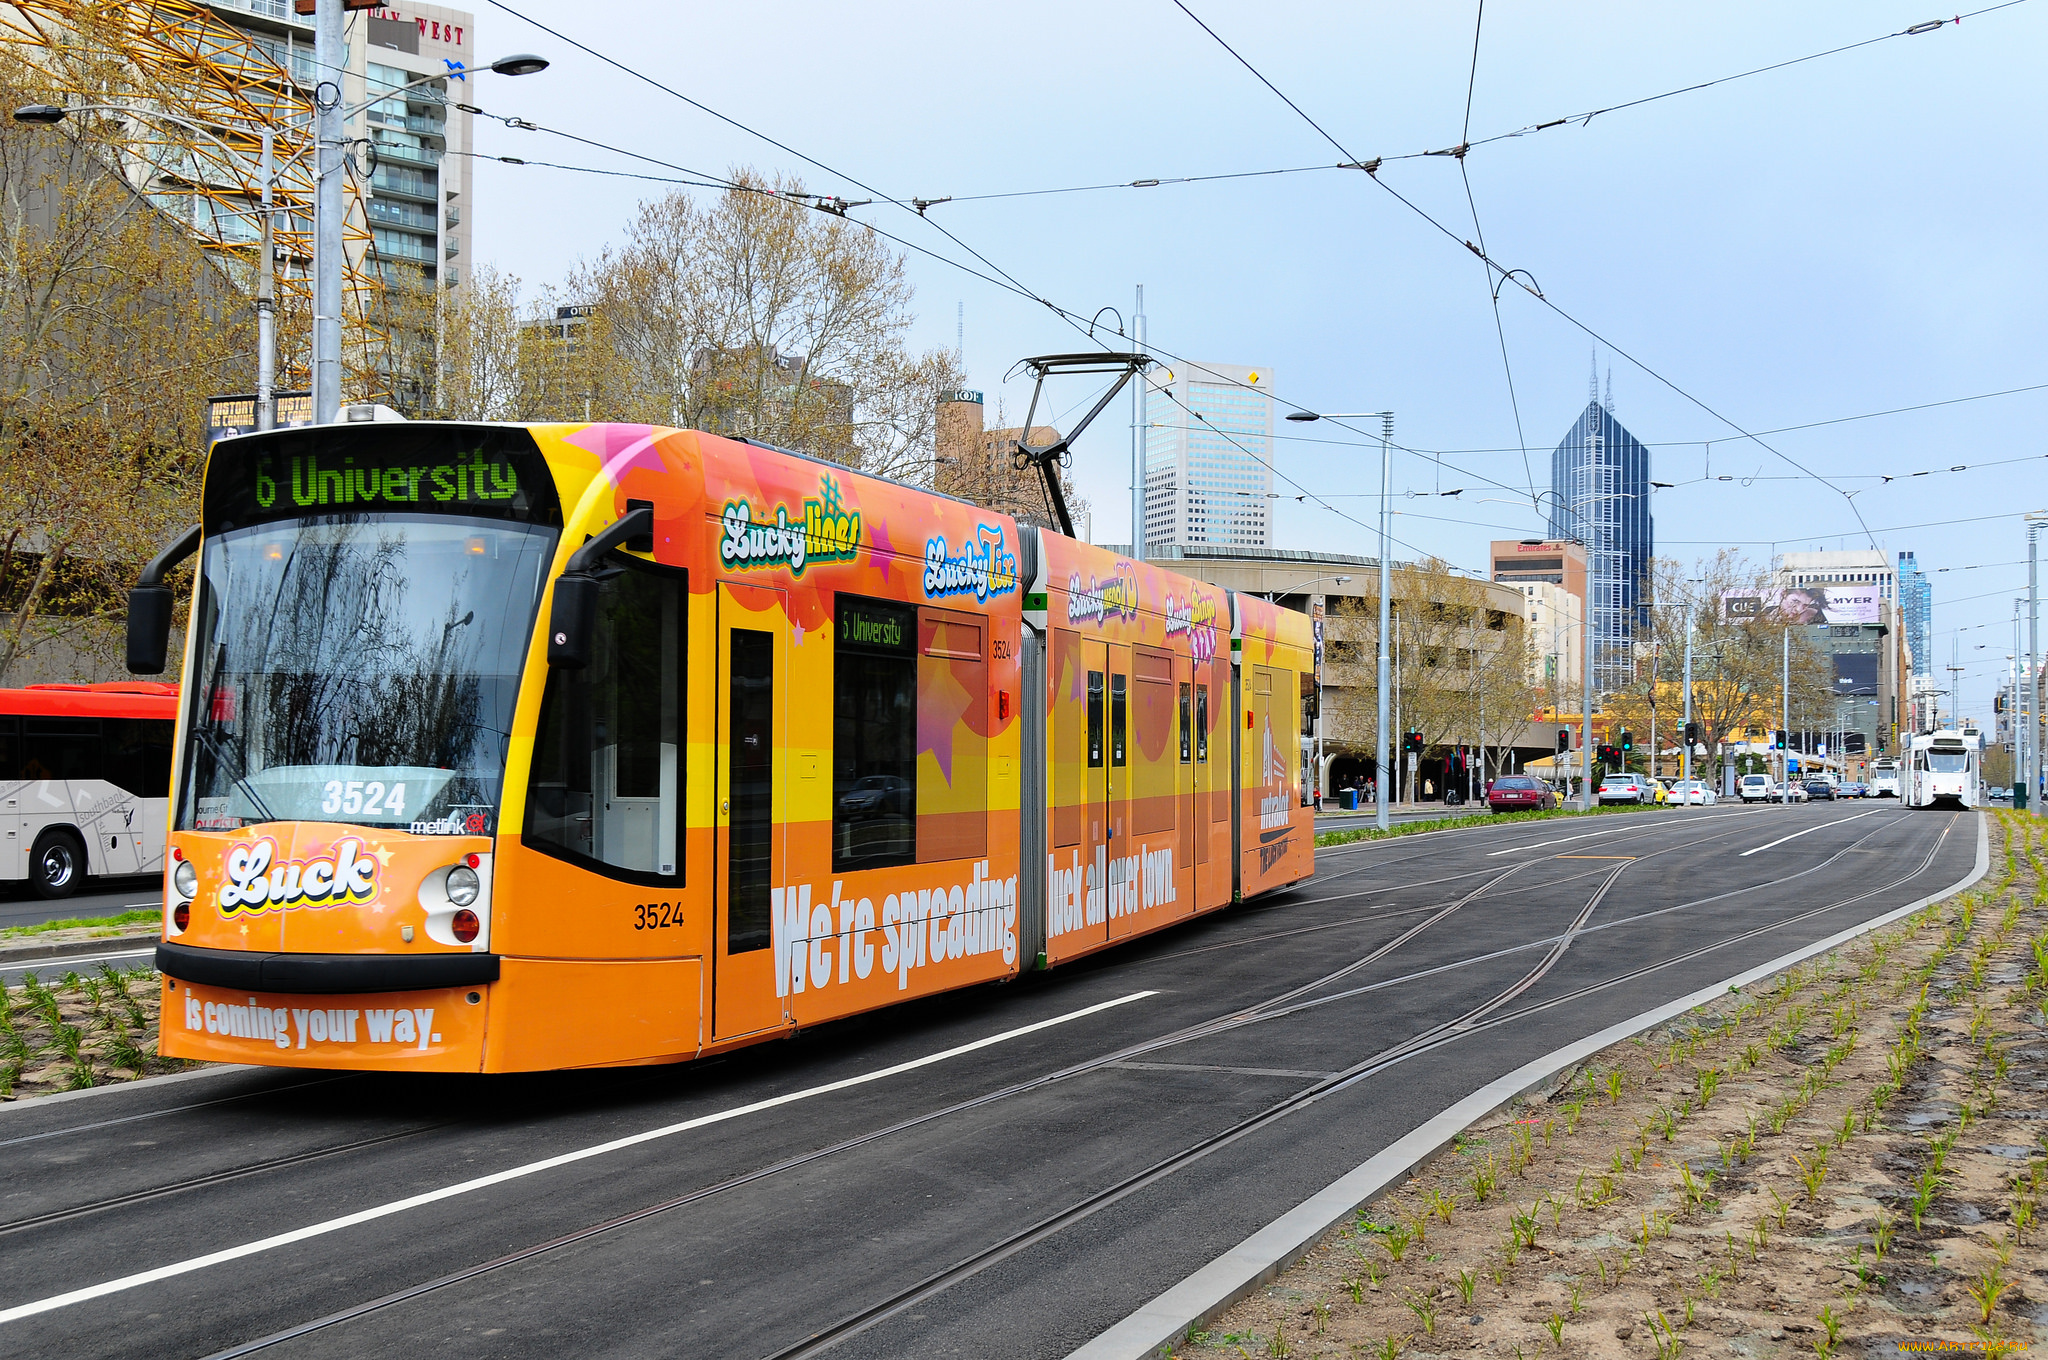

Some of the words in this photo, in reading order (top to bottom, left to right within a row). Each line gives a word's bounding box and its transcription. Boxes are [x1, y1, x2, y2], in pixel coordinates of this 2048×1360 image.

[415, 17, 463, 45] WEST
[212, 400, 255, 416] HISTORY
[277, 396, 312, 412] HISTOR
[954, 390, 979, 402] IOOF
[211, 415, 221, 427] IS
[222, 414, 255, 427] COMING
[276, 411, 287, 424] IS
[256, 456, 276, 508] 6
[292, 448, 518, 506] University
[1517, 544, 1551, 553] Emirates
[1732, 601, 1755, 613] CUE
[853, 612, 901, 645] University
[992, 640, 1011, 660] 3524
[79, 789, 125, 823] southbank
[322, 780, 406, 816] 3524
[1260, 779, 1290, 830] intralot
[410, 816, 466, 835] metlink
[219, 841, 376, 913] Luck
[633, 902, 685, 930] 3524
[771, 880, 876, 998] We're
[881, 860, 1018, 991] spreading
[1048, 853, 1084, 939] luck
[1086, 845, 1106, 926] all
[1109, 856, 1140, 919] over
[1141, 843, 1176, 909] town.
[185, 988, 203, 1031] is
[204, 997, 289, 1049] coming
[291, 1008, 360, 1049] your
[365, 1007, 442, 1050] way.
